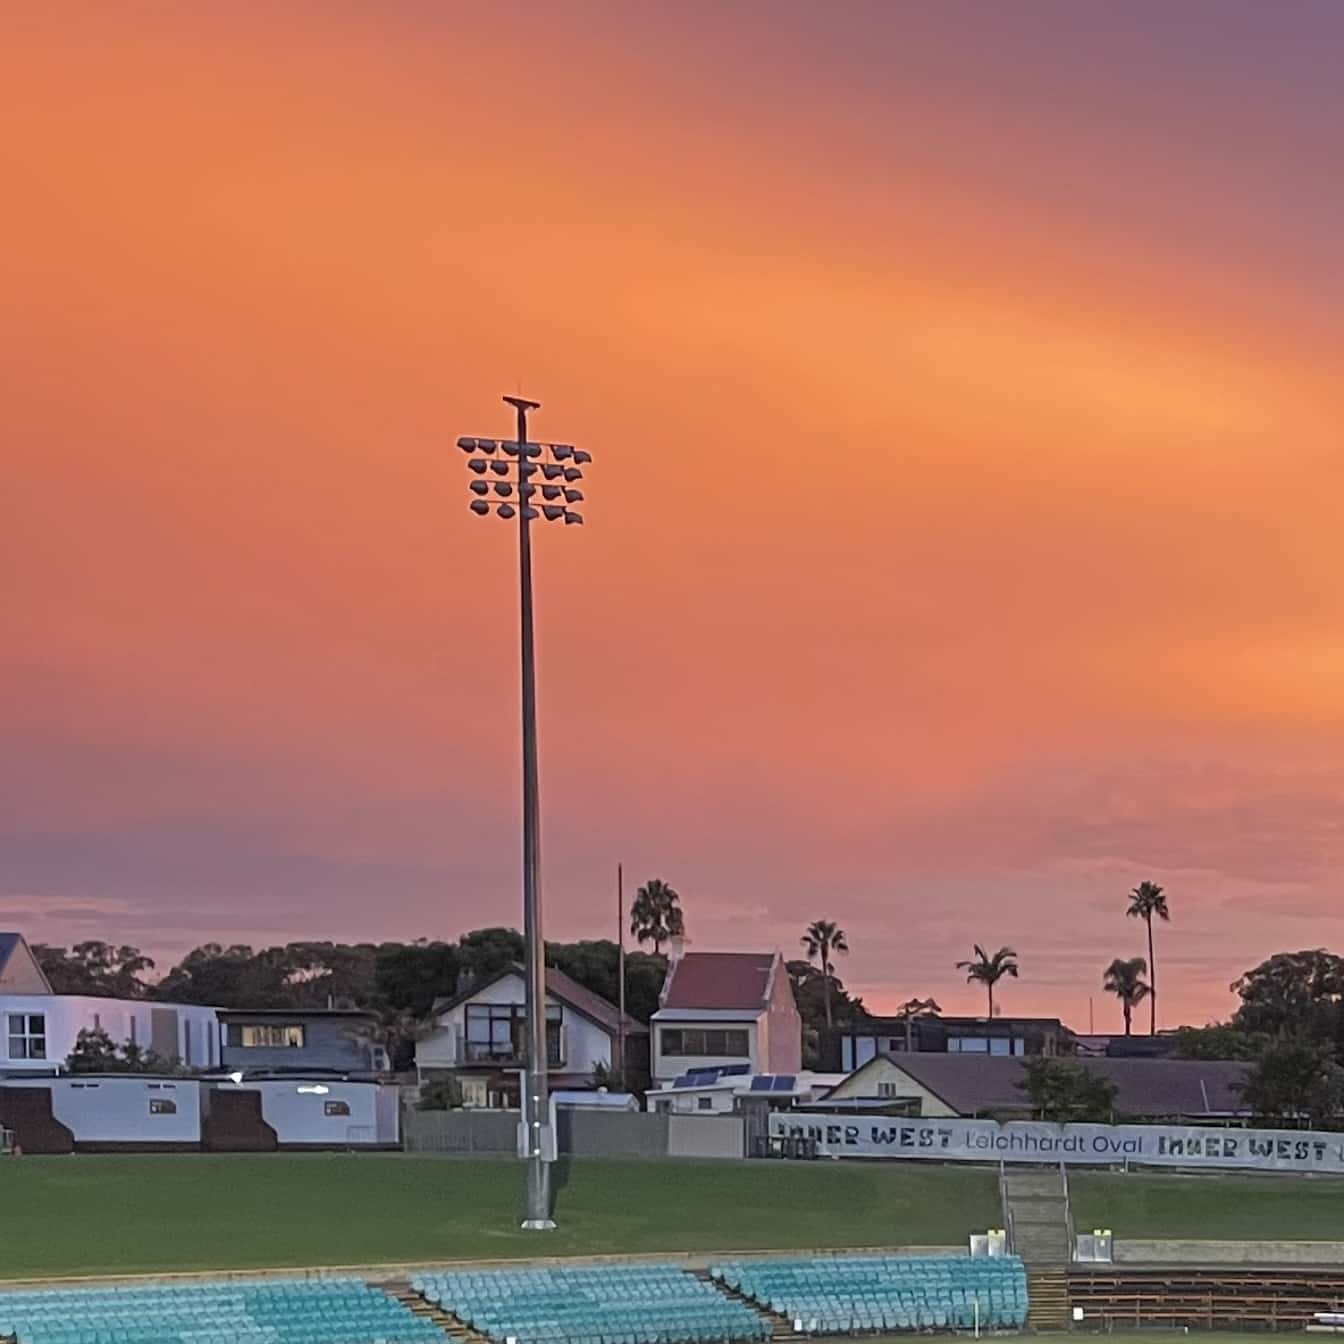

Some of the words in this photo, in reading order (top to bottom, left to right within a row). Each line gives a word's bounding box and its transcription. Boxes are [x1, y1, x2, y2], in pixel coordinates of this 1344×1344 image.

[872, 1127, 953, 1147] WEST
[966, 1131, 1086, 1151] Leichhardt
[1092, 1135, 1142, 1153] Oval
[1249, 1139, 1327, 1160] WEST
